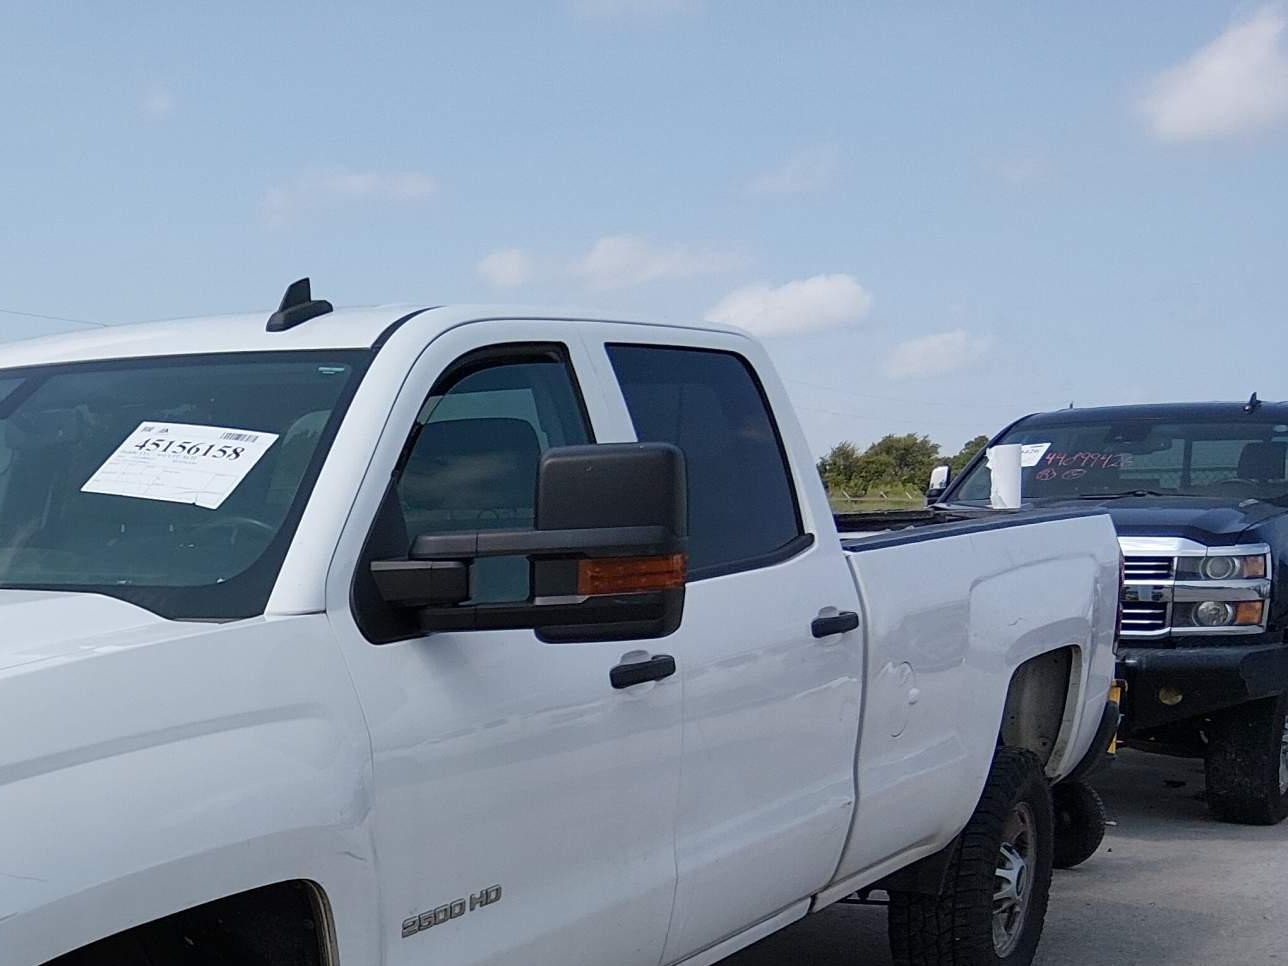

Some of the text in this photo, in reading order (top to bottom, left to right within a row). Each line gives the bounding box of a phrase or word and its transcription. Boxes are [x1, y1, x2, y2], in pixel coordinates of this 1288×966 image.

[134, 437, 245, 462] 45156158
[402, 883, 502, 938] 2500 HD
